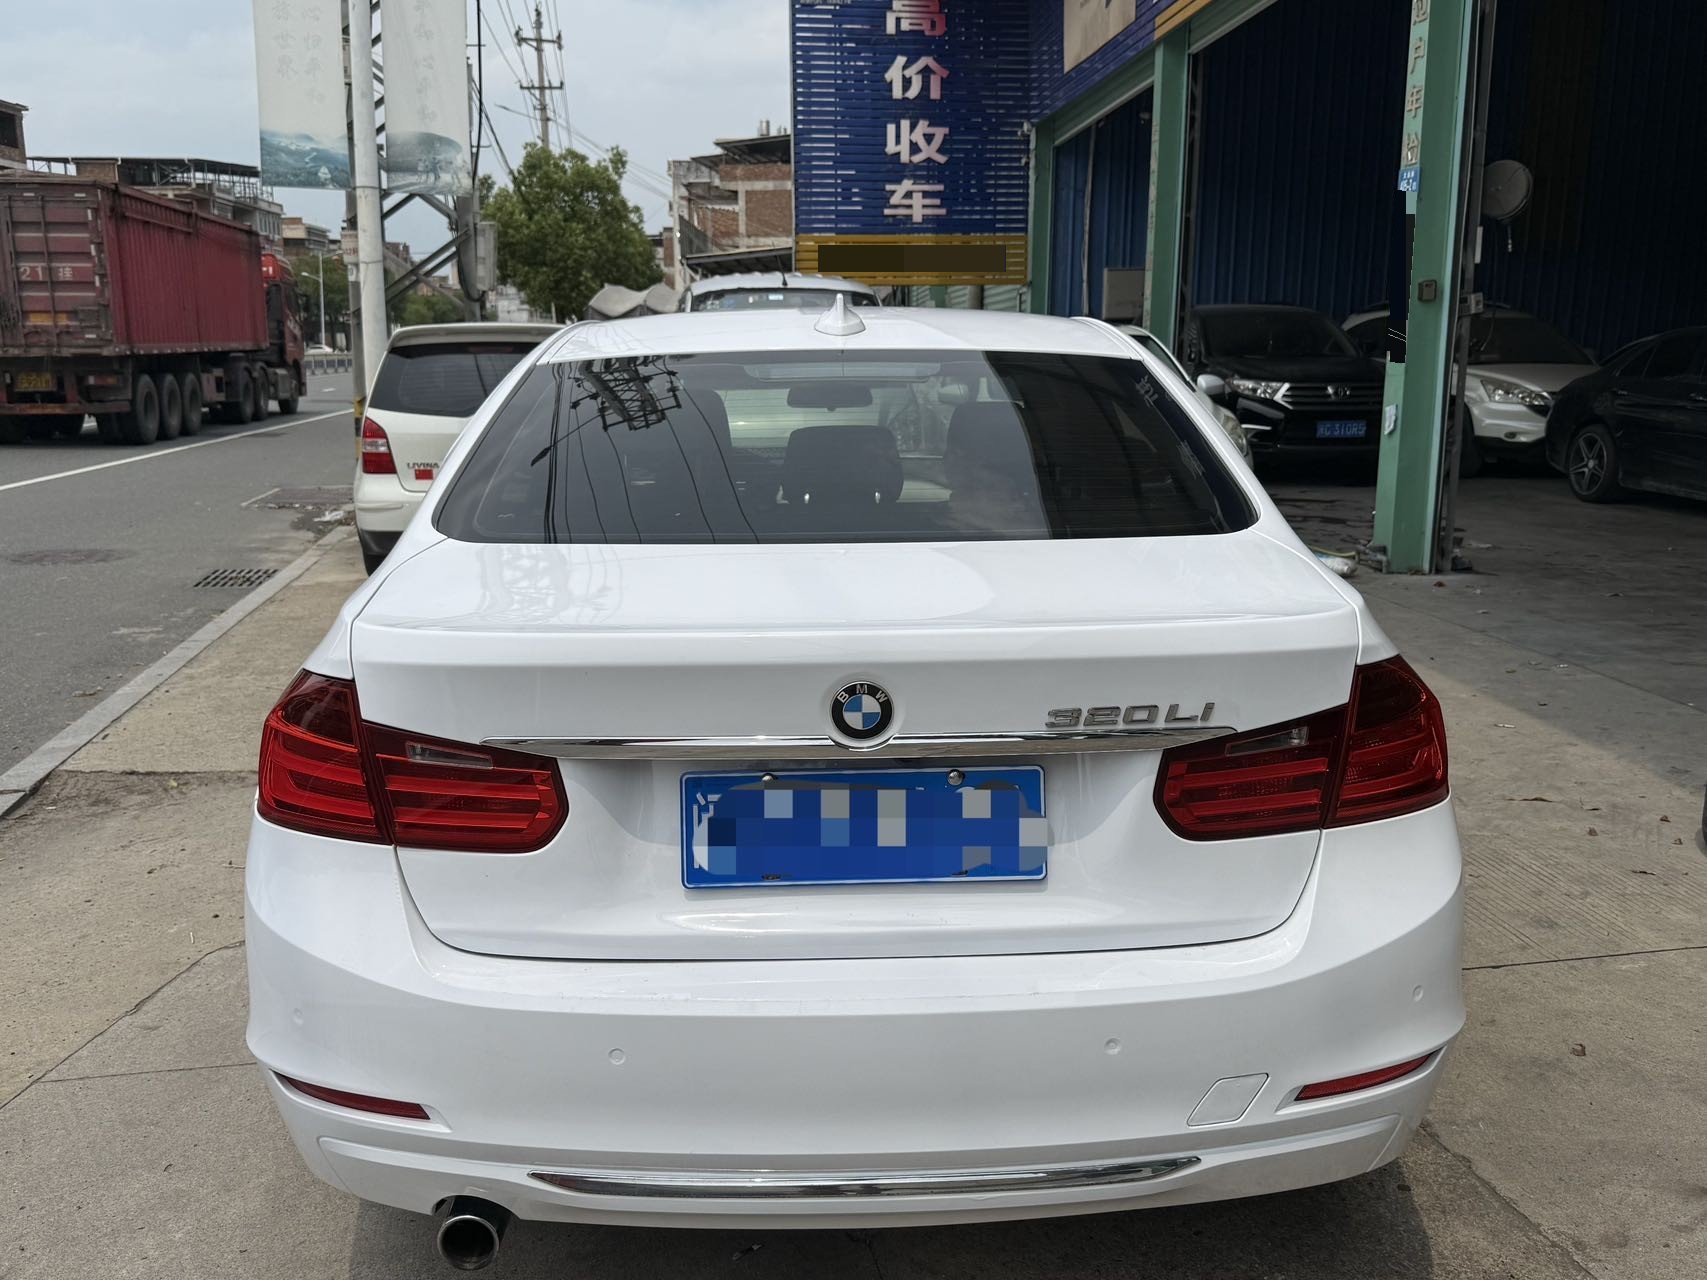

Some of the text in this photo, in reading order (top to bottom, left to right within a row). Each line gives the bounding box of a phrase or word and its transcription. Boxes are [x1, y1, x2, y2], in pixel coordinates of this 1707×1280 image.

[883, 0, 950, 224] 高价收车
[837, 683, 888, 704] BMW
